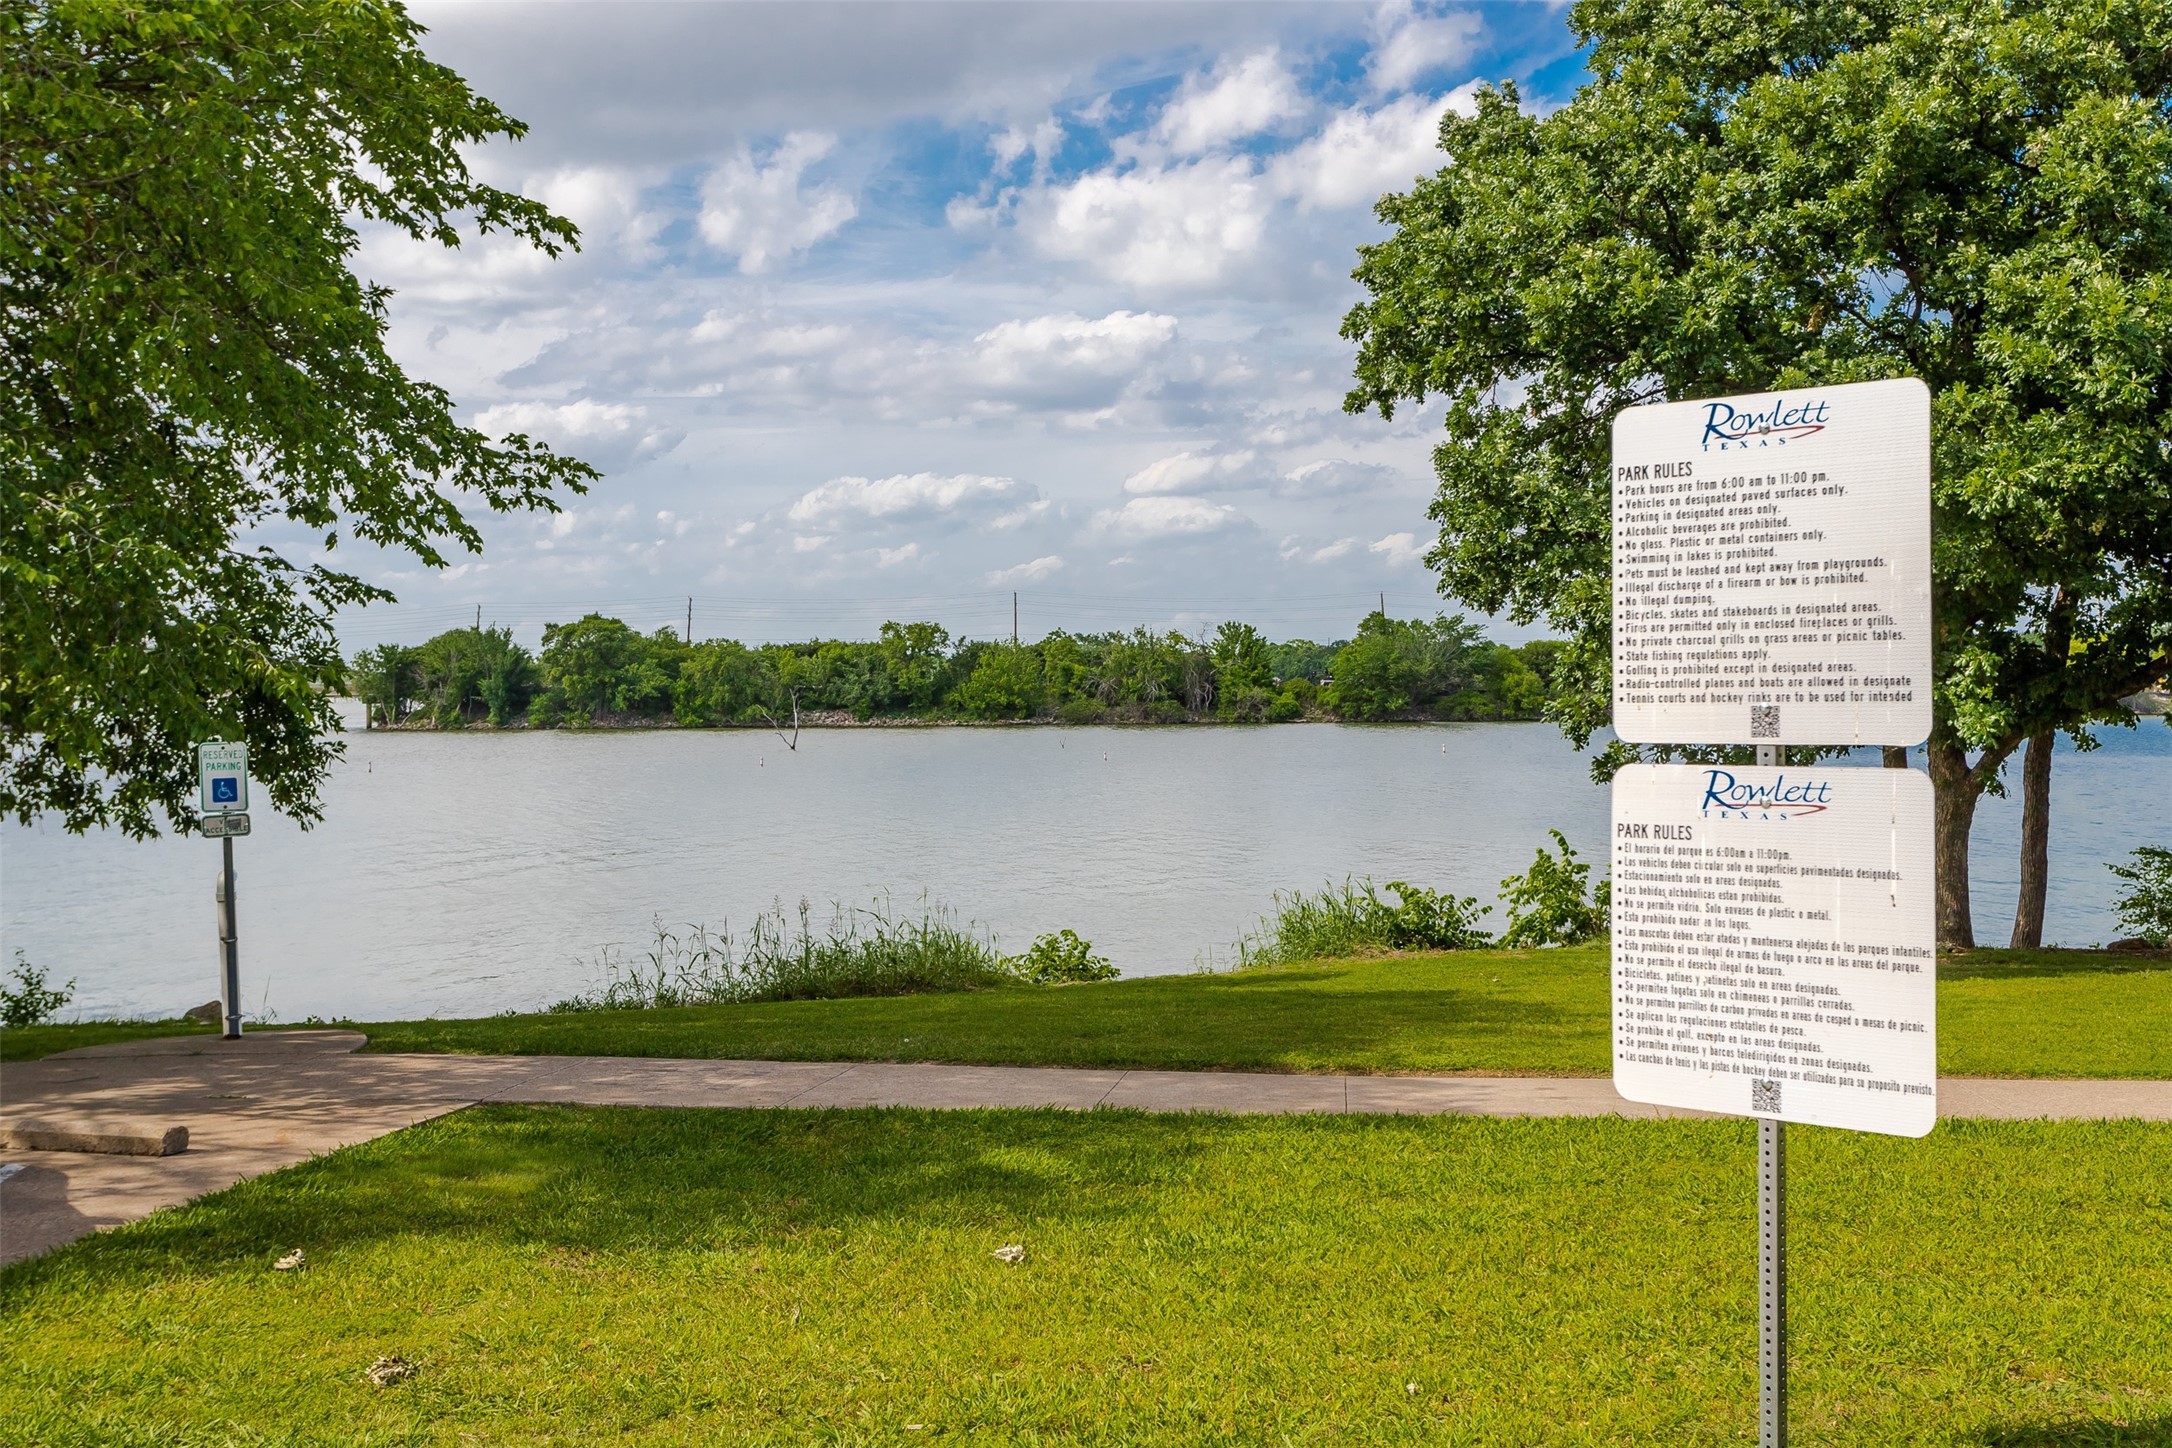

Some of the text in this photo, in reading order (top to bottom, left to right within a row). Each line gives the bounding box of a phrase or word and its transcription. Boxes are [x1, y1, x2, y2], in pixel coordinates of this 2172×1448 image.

[1702, 400, 1830, 444] Rowlett
[1702, 438, 1786, 452] TEXAS
[1618, 462, 1692, 482] PARK RULES
[1625, 484, 1646, 496] Park
[1649, 484, 1674, 494] hours
[1678, 483, 1692, 492] are
[1696, 480, 1717, 491] from
[1721, 476, 1745, 489] 6:00
[1748, 477, 1762, 487] am
[1766, 474, 1776, 486] to
[1780, 472, 1807, 484] 11:00
[1625, 498, 1666, 509] Vehicles
[1669, 498, 1680, 506] on
[1685, 492, 1737, 506] designated
[1742, 489, 1770, 503] paved
[1775, 487, 1818, 499] surfaces
[1625, 512, 1659, 524] Parking
[1663, 510, 1672, 520] in
[1676, 507, 1724, 521] designated
[1728, 507, 1753, 516] areas
[1625, 525, 1668, 537] Alcoholic
[1672, 524, 1717, 535] beverages
[1720, 522, 1736, 531] are
[1625, 540, 1637, 550] No
[1670, 536, 1701, 548] Plastic
[1705, 537, 1715, 546] or
[1719, 534, 1744, 545] metal
[1748, 531, 1798, 543] containers
[1626, 553, 1670, 565] Swimming
[1674, 552, 1683, 562] in
[1687, 551, 1711, 561] lakes
[1714, 549, 1722, 560] is
[1647, 567, 1668, 578] must
[1672, 567, 1682, 577] be
[1686, 565, 1720, 576] leashed
[1724, 563, 1741, 574] and
[1745, 562, 1766, 575] kept
[1769, 563, 1793, 574] away
[1797, 560, 1819, 571] from
[1625, 582, 1654, 594] Illegal
[1658, 581, 1702, 592] discharge
[1705, 578, 1714, 589] of
[1718, 580, 1723, 589] a
[1727, 578, 1761, 588] firearm
[1765, 578, 1776, 587] or
[1780, 576, 1798, 586] bow
[1802, 574, 1810, 585] is
[1625, 596, 1637, 606] No
[1641, 595, 1669, 608] illegal
[1670, 608, 1698, 619] skates
[1702, 607, 1718, 618] and
[1722, 605, 1778, 617] stakeboards
[1782, 604, 1791, 615] in
[1795, 602, 1847, 616] designated
[1625, 623, 1647, 633] Fires
[1650, 624, 1665, 633] are
[1669, 621, 1712, 634] permitted
[1716, 620, 1737, 632] only
[1741, 619, 1750, 630] in
[1754, 618, 1795, 629] enclosed
[1852, 618, 1862, 626] or
[1626, 636, 1637, 647] No
[1641, 636, 1672, 648] private
[1676, 635, 1716, 646] charcoal
[1720, 634, 1745, 647] grills
[1748, 635, 1760, 644] on
[1764, 635, 1788, 646] grass
[1792, 634, 1818, 643] areas
[1822, 633, 1832, 642] or
[1836, 630, 1867, 644] picnic
[1626, 651, 1648, 661] State
[1652, 650, 1682, 663] fishing
[1686, 649, 1738, 662] regulations
[1626, 665, 1658, 678] Golfing
[1661, 664, 1669, 675] is
[1673, 664, 1719, 676] prohibited
[1723, 663, 1754, 675] except
[1758, 662, 1768, 673] in
[1772, 662, 1823, 675] designated
[1626, 675, 1911, 690] Radio-controlled planes and boats are allowed in designate
[1626, 690, 1912, 705] Tennis courts and hockey rinks are to be used for intended
[203, 750, 243, 759] RESERVED
[206, 762, 241, 771] PARKING
[1702, 770, 1832, 810] Rowlett
[1704, 810, 1788, 820] TEXAS
[1618, 823, 1692, 840] PARK RULES
[1624, 842, 1632, 853] El
[1634, 844, 1660, 854] horario
[1663, 845, 1674, 855] del
[1678, 847, 1702, 858] parque
[1749, 850, 1754, 859] a
[1624, 953, 1634, 964] No
[1636, 957, 1644, 965] se
[1647, 957, 1674, 967] permite
[1678, 958, 1684, 968] el
[1688, 959, 1717, 971] desecho
[1720, 961, 1742, 975] ilegal
[1744, 963, 1754, 974] de
[1626, 1036, 1634, 1047] Se
[1637, 1040, 1669, 1050] permiten
[1671, 1042, 1699, 1054] aviones
[1702, 1047, 1707, 1057] y
[1710, 1046, 1734, 1058] barcos
[1737, 1049, 1786, 1064] teledirigidos
[1789, 1056, 1798, 1065] en
[1801, 1057, 1823, 1068] zonas
